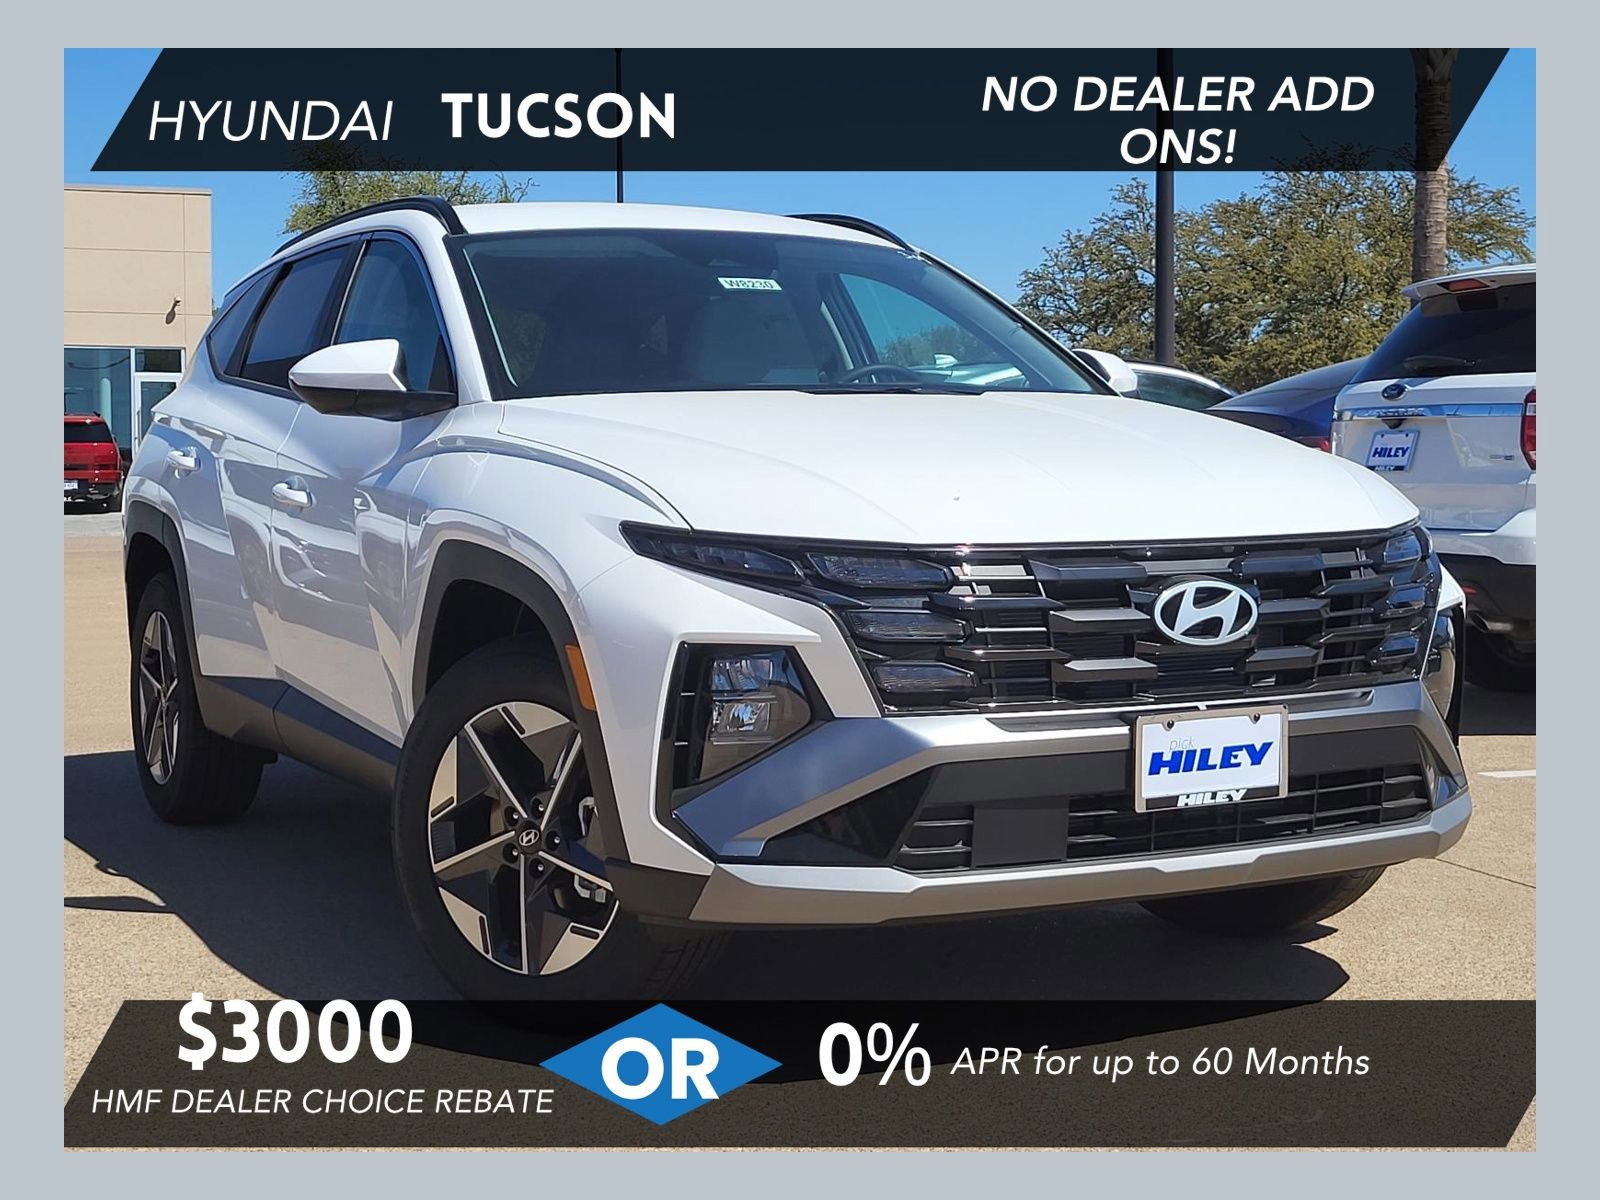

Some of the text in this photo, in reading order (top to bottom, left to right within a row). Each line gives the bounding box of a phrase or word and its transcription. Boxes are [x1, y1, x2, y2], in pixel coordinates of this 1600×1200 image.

[1372, 446, 1410, 458] HILEY
[1148, 741, 1273, 776] HILEY
[1177, 788, 1247, 807] HILEY
